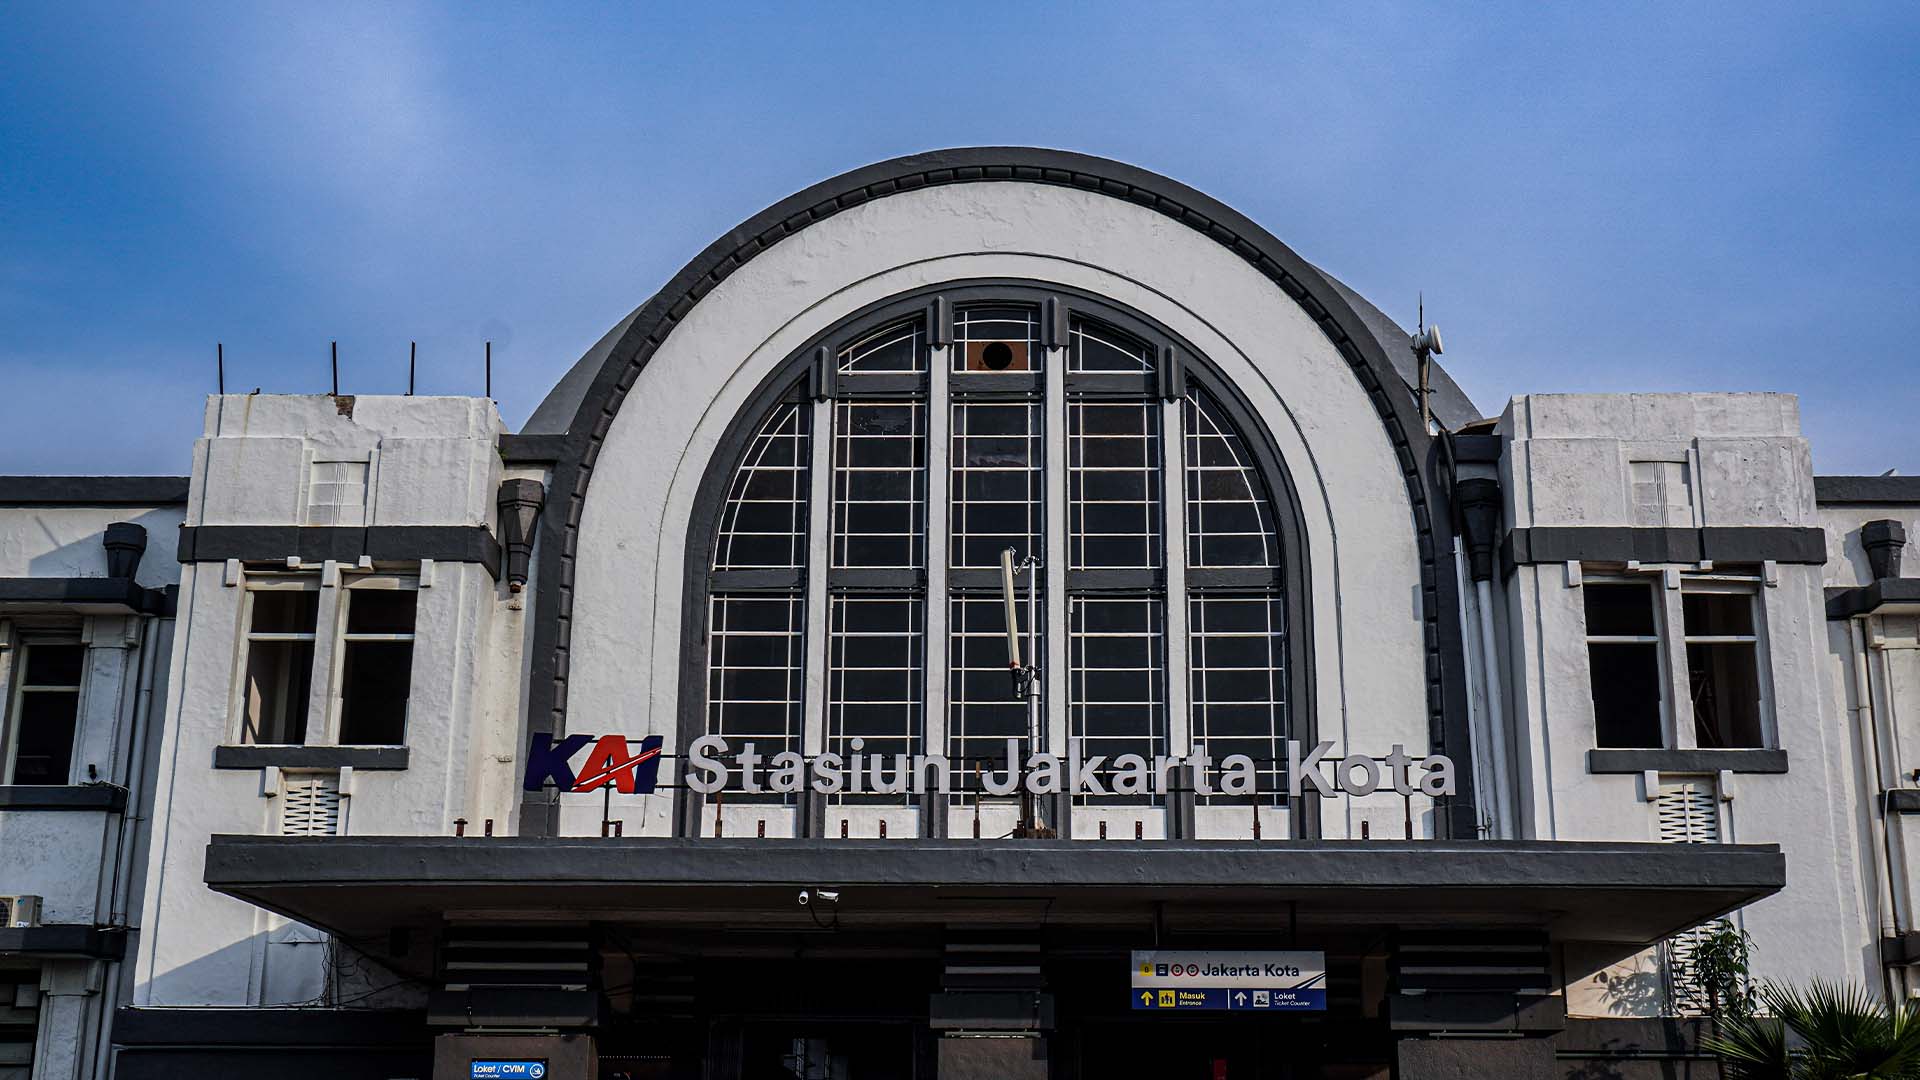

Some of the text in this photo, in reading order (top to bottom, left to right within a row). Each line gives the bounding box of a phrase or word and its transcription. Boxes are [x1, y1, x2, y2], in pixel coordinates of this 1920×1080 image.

[523, 733, 663, 794] KAI
[685, 735, 1456, 798] Stasiun Jakarta Kota
[1202, 963, 1260, 977] Jakarta
[1264, 963, 1300, 977] Kota
[1179, 991, 1206, 1000] Masuk
[1274, 991, 1296, 1000] Loket
[474, 1064, 496, 1073] Loket
[502, 1064, 525, 1073] CVIM
